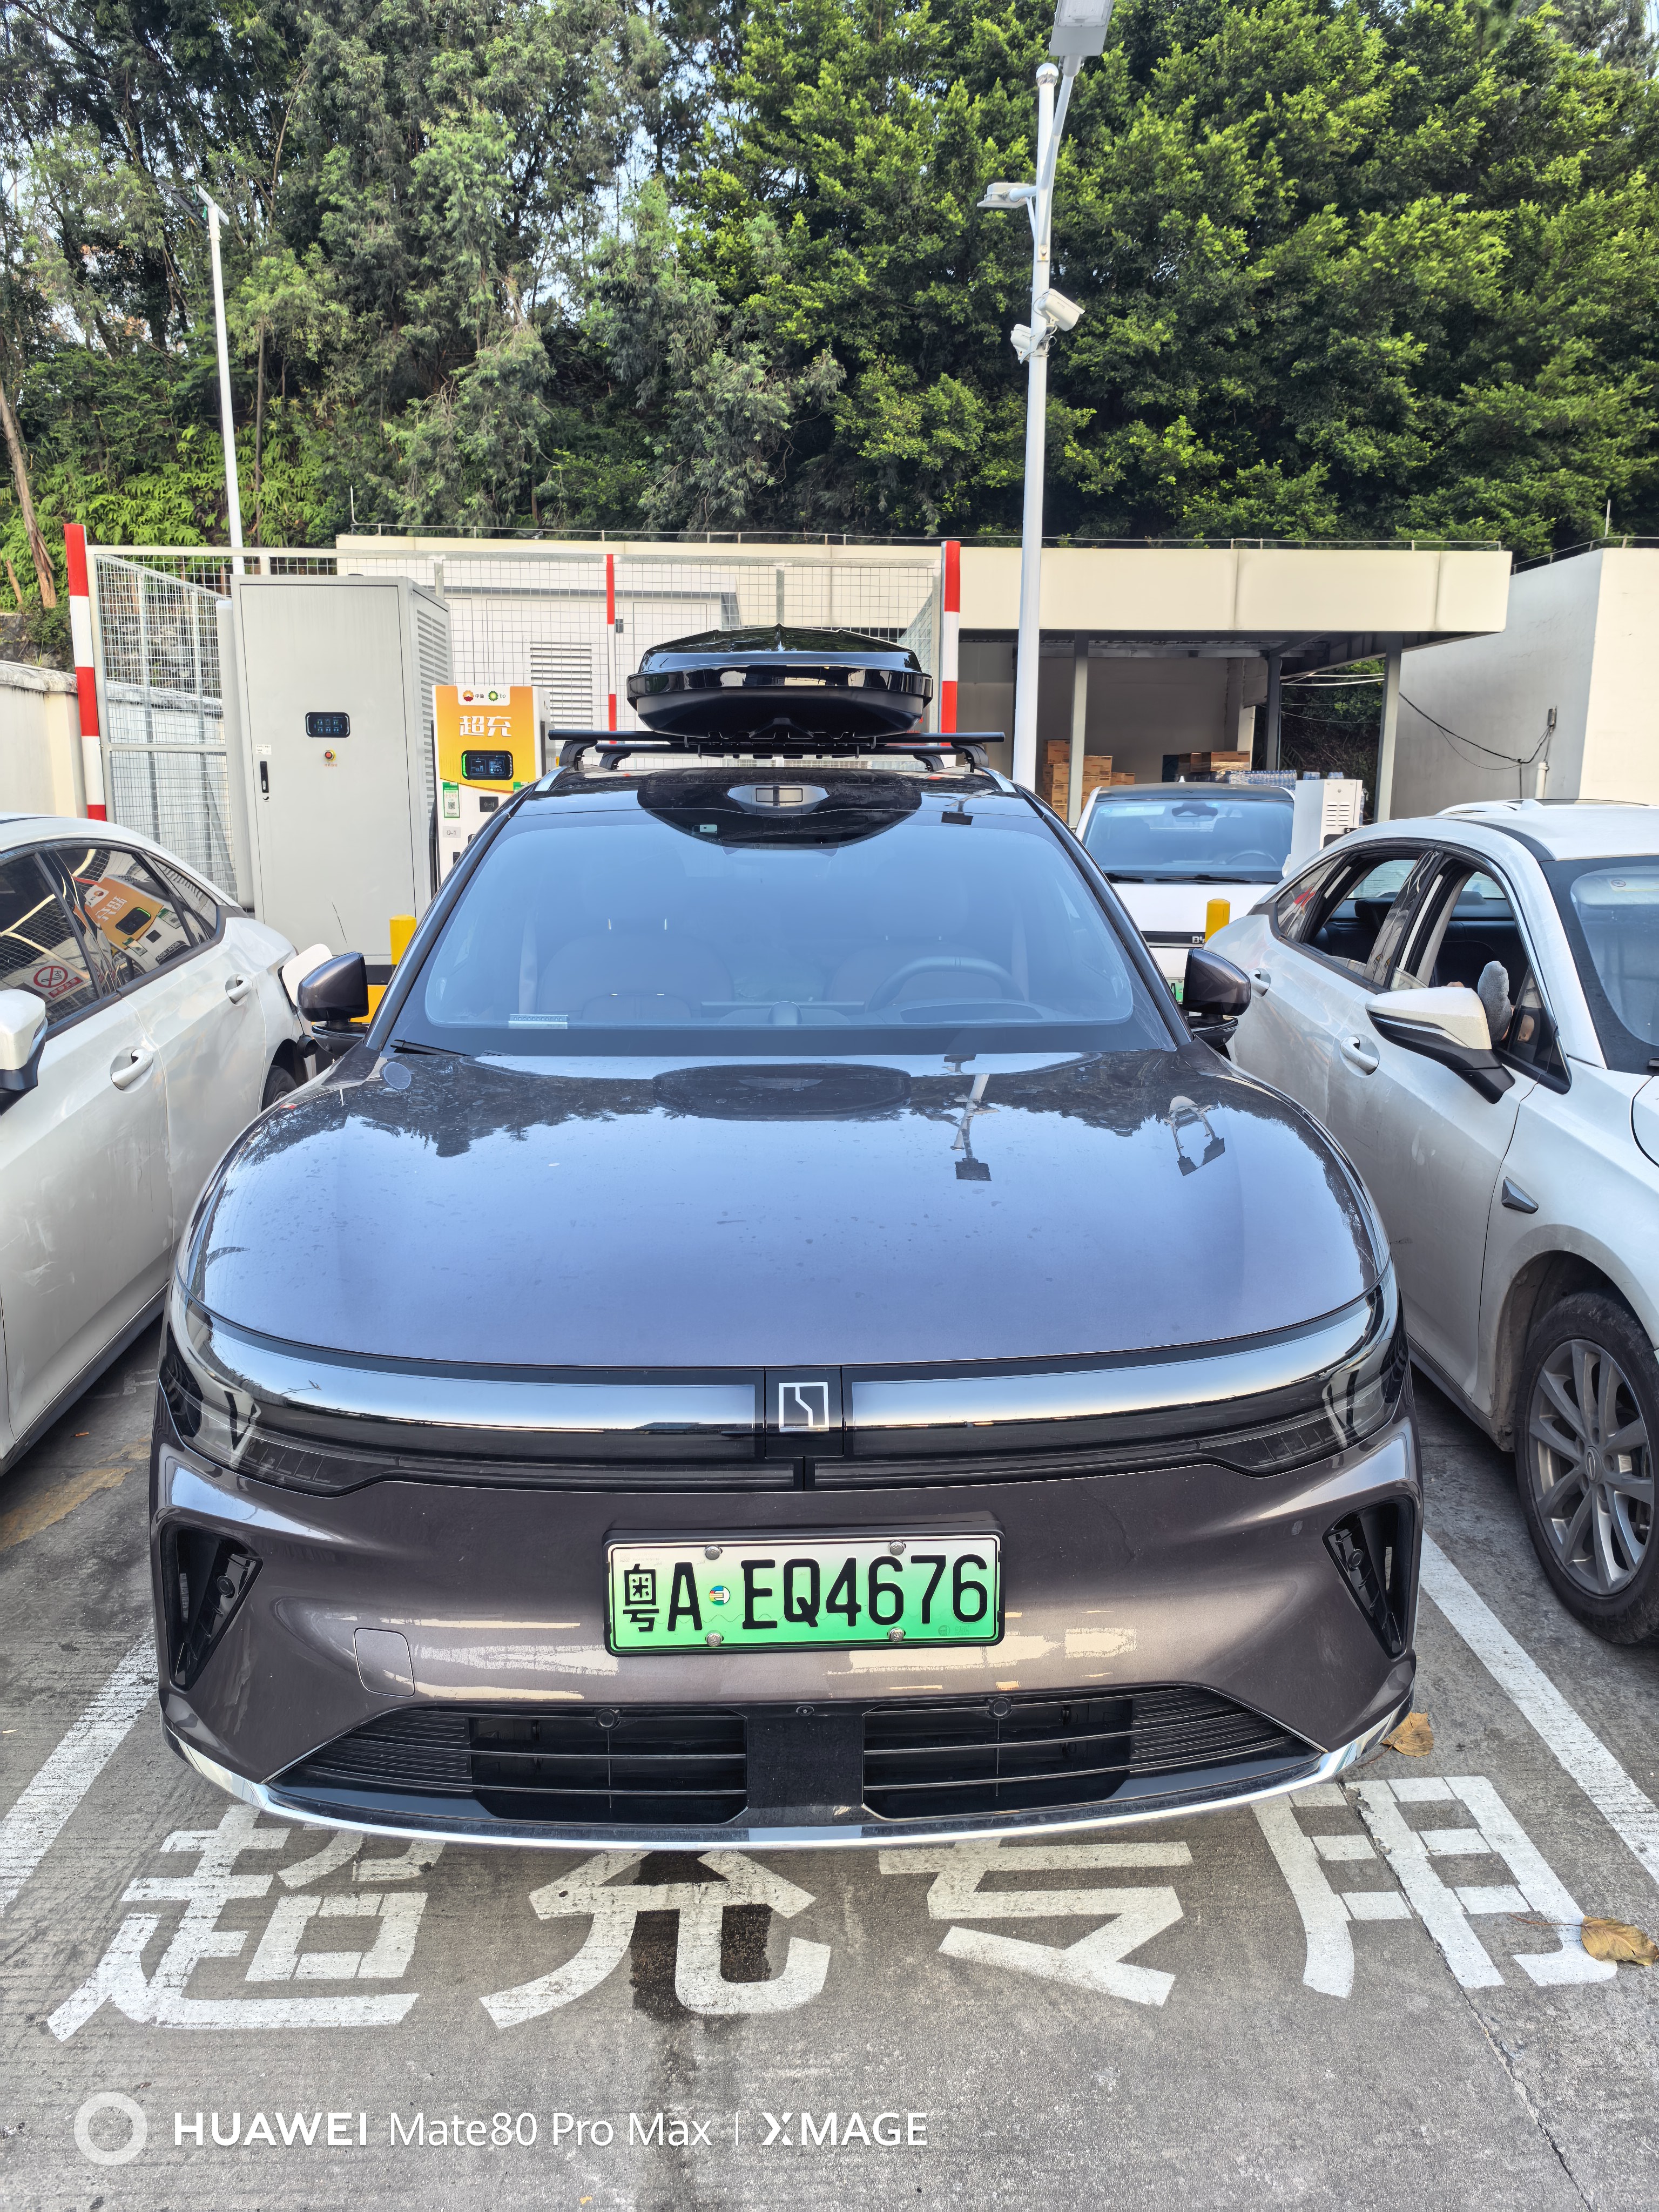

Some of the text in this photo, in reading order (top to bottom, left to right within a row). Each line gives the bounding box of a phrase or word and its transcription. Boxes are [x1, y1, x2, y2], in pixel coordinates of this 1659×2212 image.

[460, 715, 512, 737] 超充
[623, 1554, 988, 1632] 粤A EQ4676
[46, 1775, 1618, 2042] 超充专用
